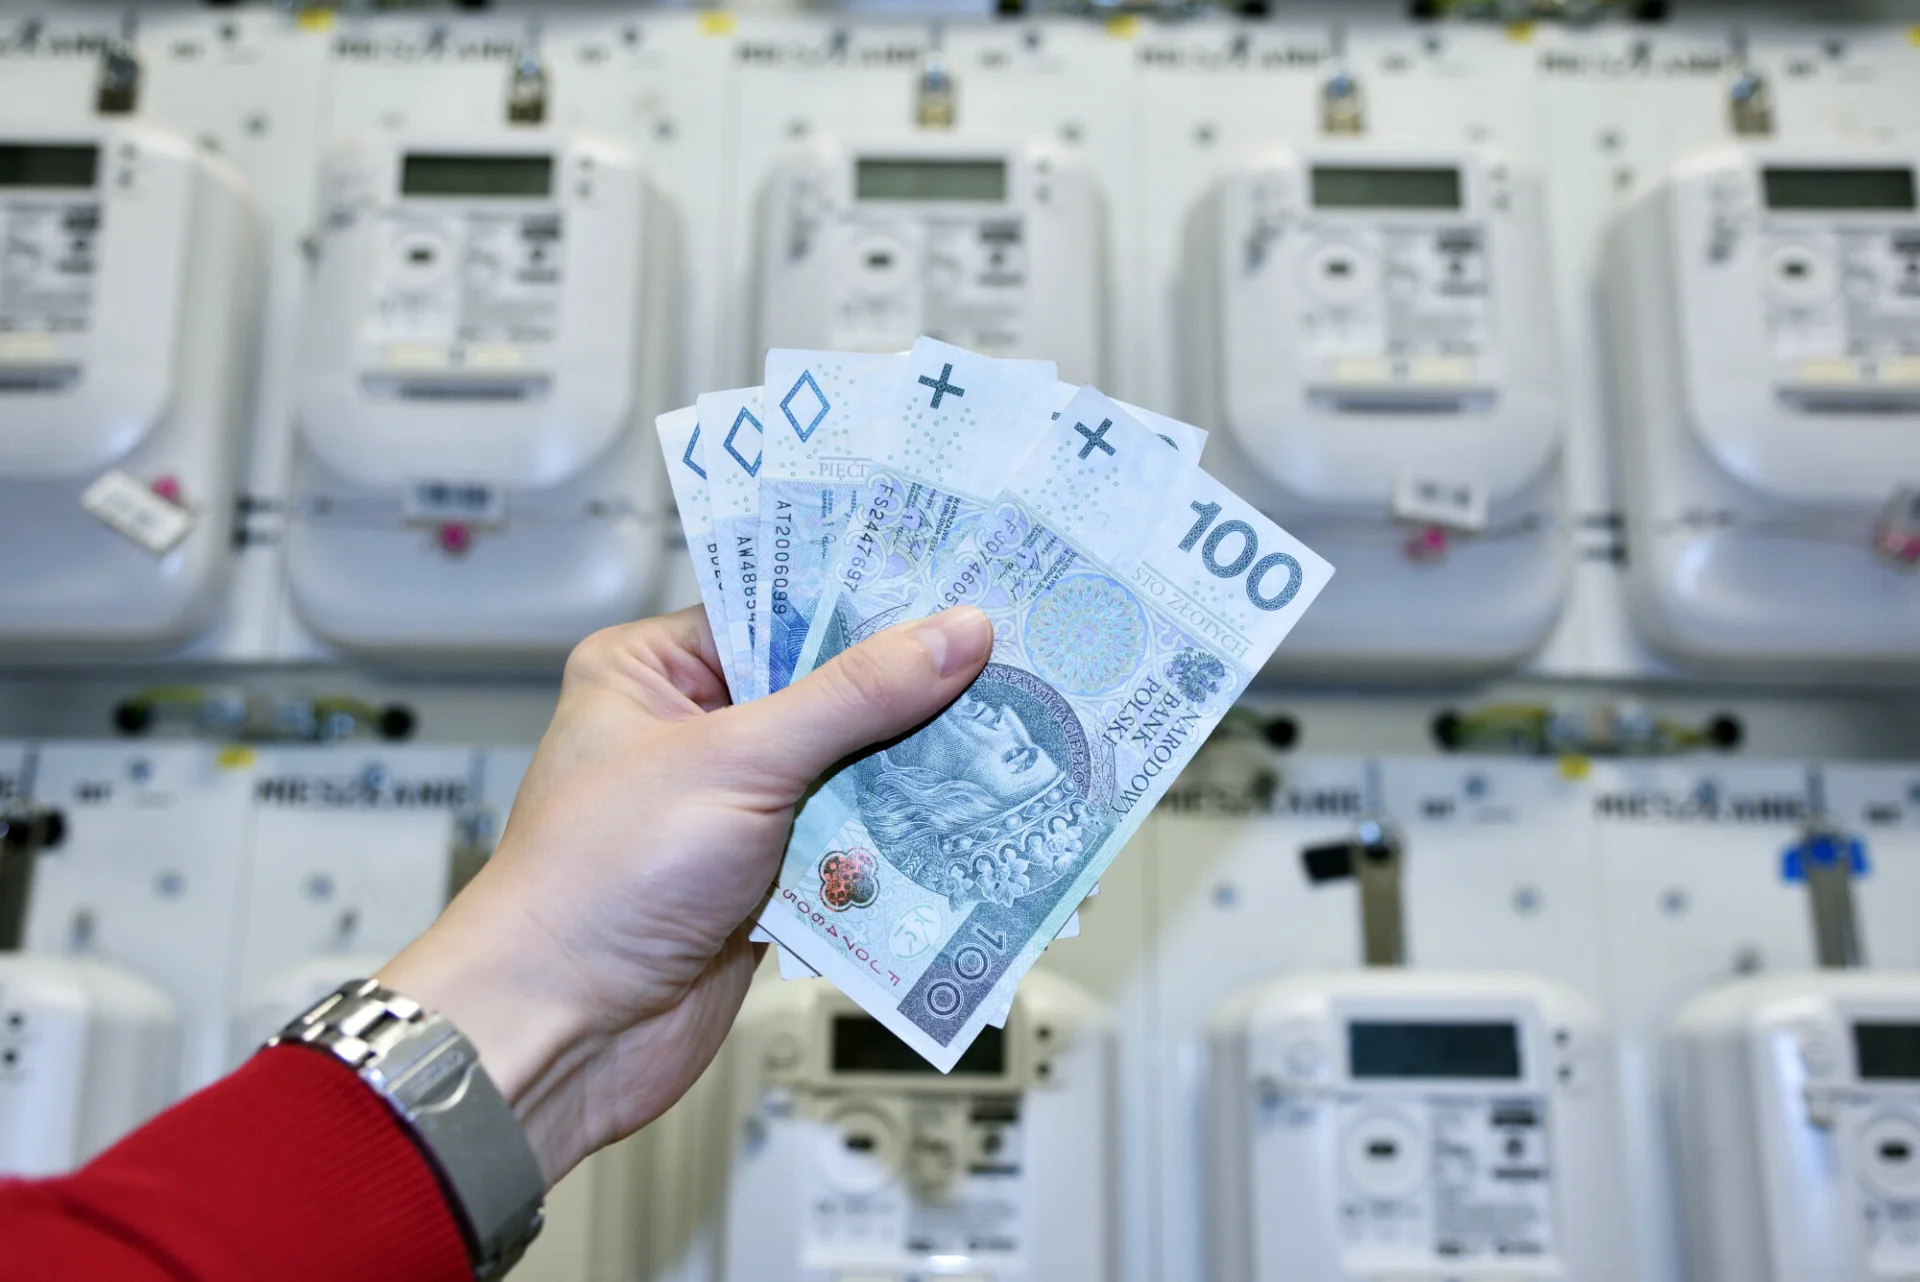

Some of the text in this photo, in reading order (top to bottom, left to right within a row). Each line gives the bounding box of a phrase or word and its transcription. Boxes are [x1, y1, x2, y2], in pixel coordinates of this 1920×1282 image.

[772, 500, 792, 615] AT2006099
[843, 483, 894, 593] FS2447697
[940, 496, 960, 542] WARSZAWA
[1178, 500, 1303, 611] 100
[1131, 567, 1250, 658] STO ZŁOTYCH
[1103, 676, 1164, 748] POLSKI
[1131, 690, 1183, 749] BANK
[1116, 711, 1202, 822] NARODOWY
[925, 924, 1007, 1019] 100
